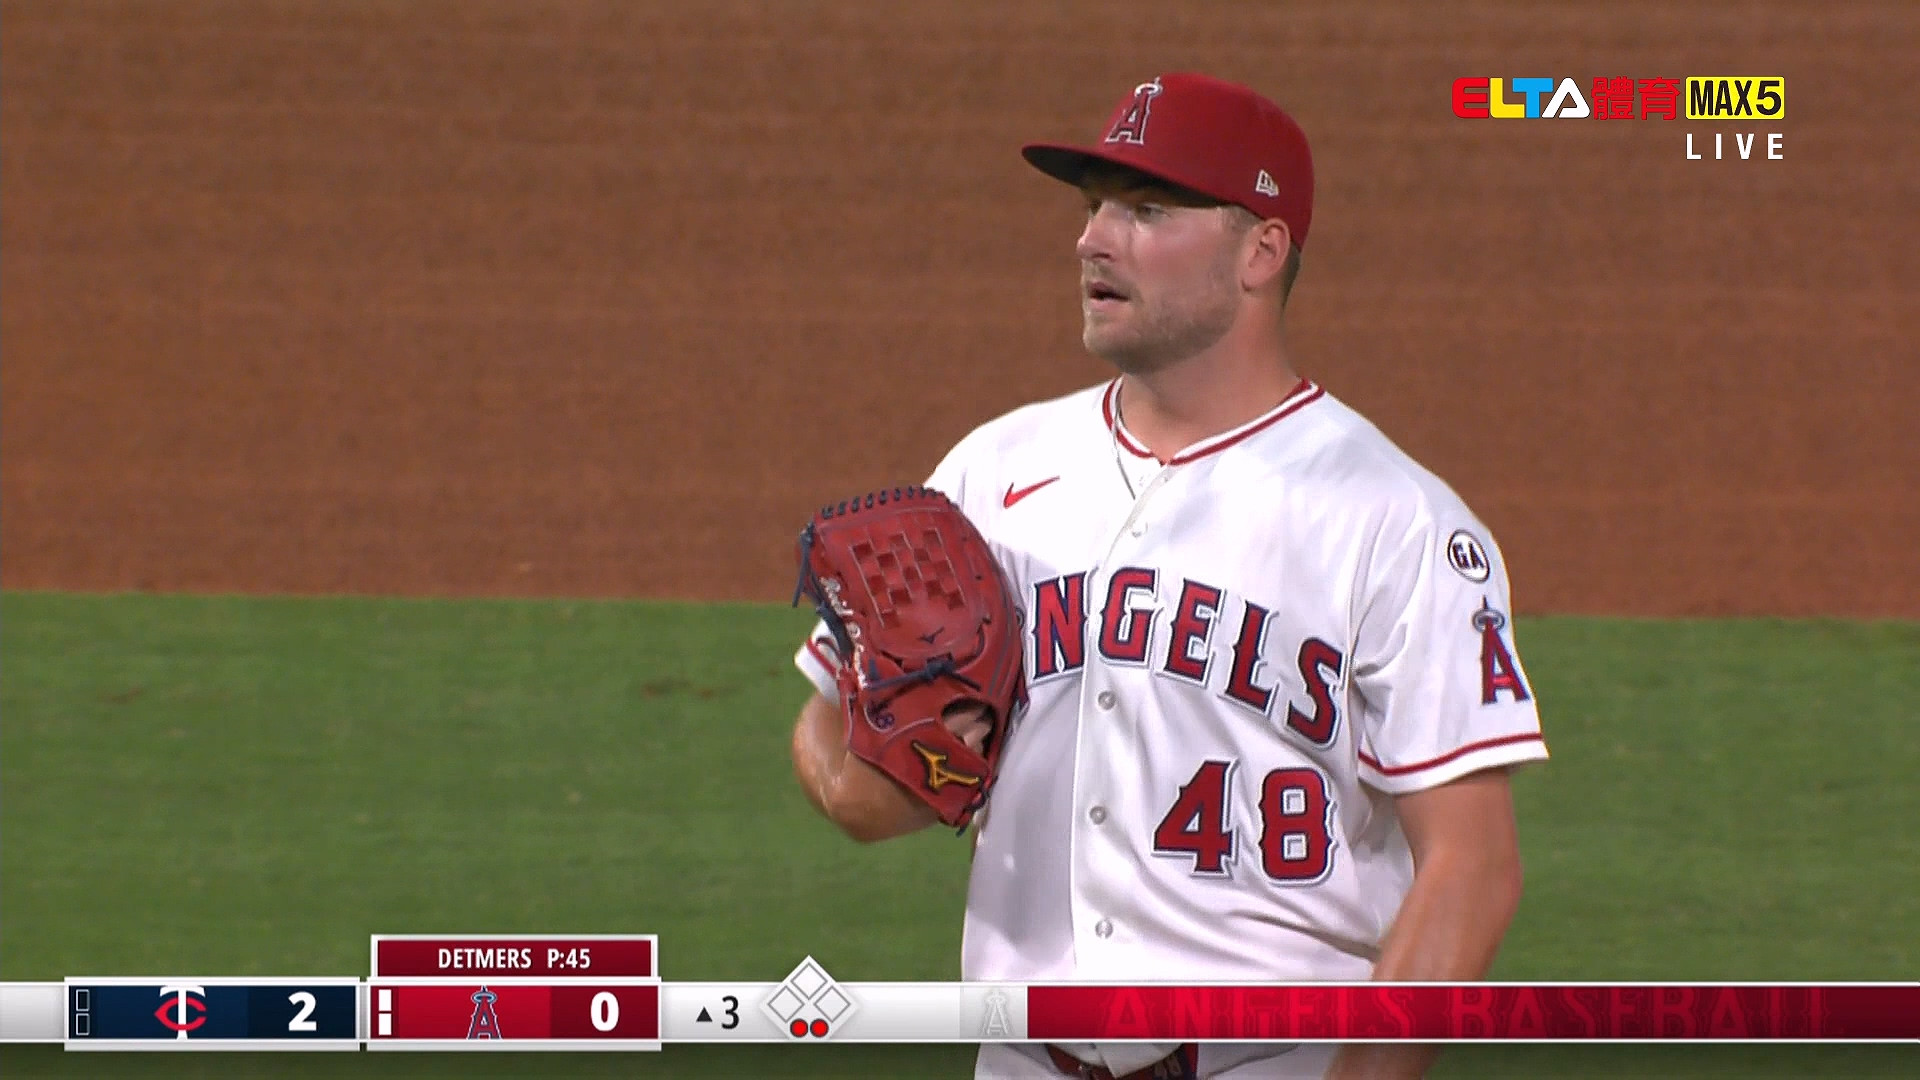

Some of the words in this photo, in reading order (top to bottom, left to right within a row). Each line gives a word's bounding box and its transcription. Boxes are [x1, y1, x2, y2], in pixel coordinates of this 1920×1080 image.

[1105, 77, 1162, 145] A
[1451, 541, 1484, 569] GA
[1024, 566, 1347, 750] NGELS
[1473, 595, 1530, 706] A
[1152, 757, 1337, 887] 48
